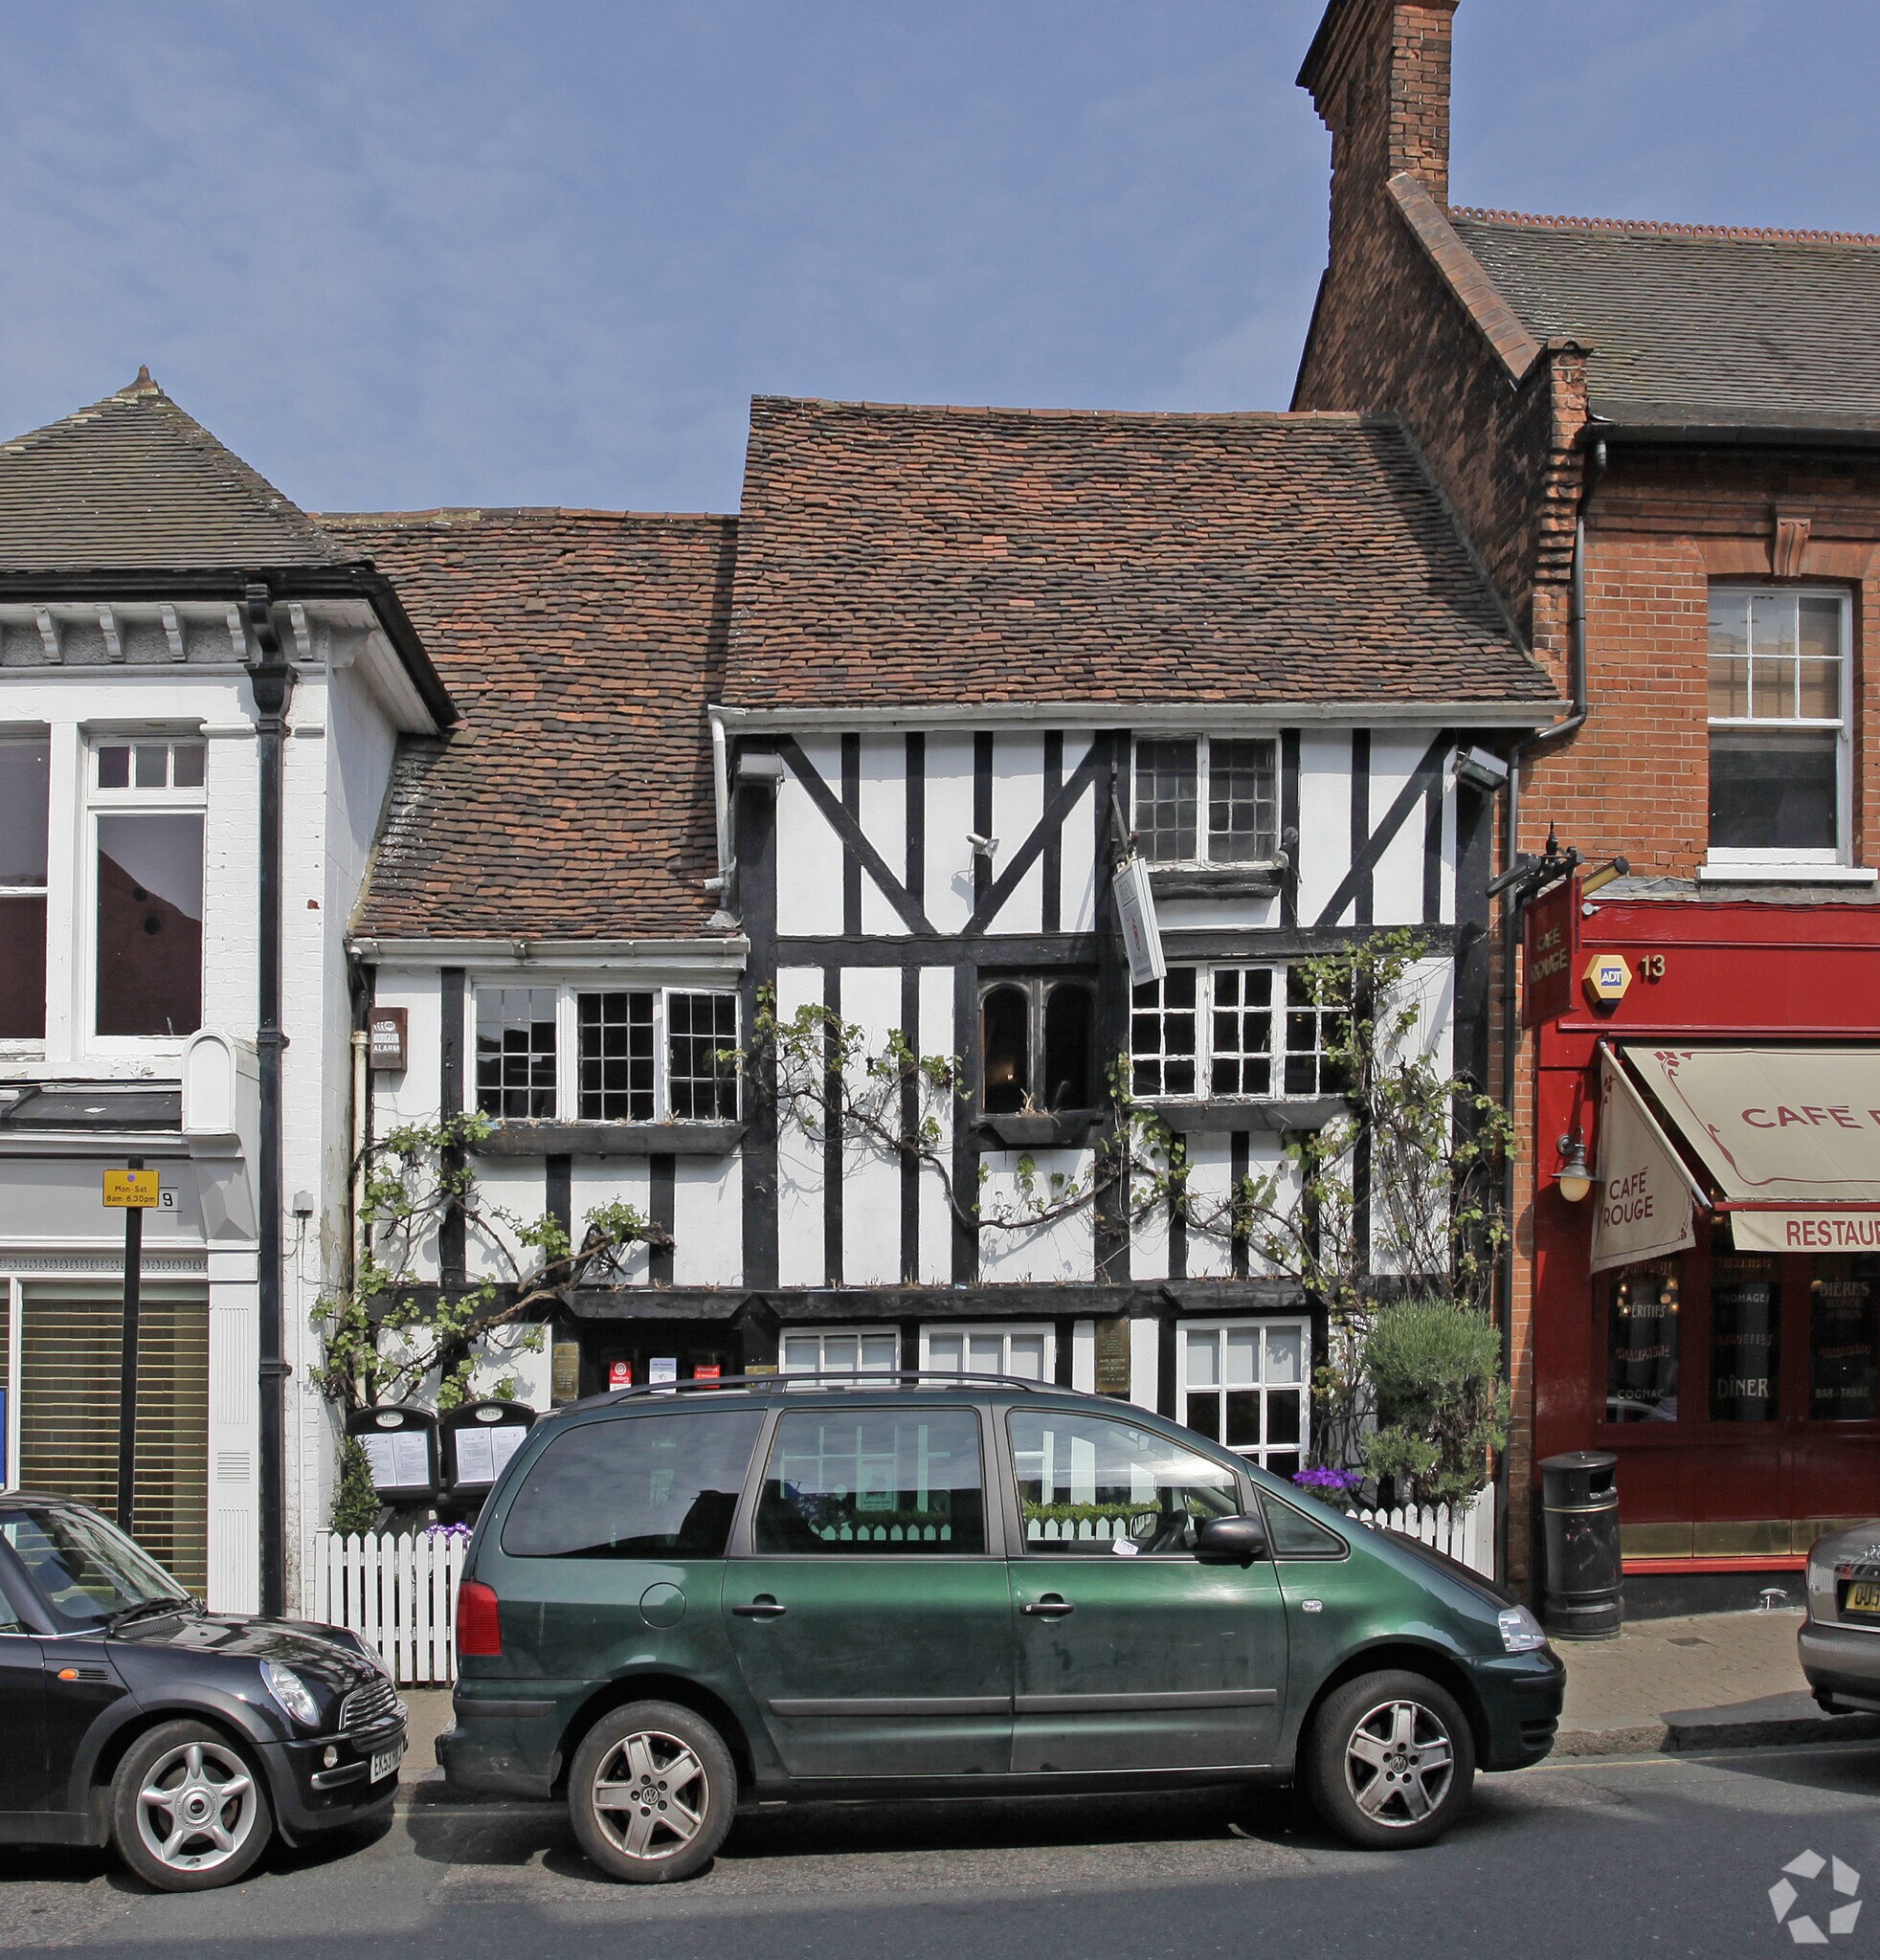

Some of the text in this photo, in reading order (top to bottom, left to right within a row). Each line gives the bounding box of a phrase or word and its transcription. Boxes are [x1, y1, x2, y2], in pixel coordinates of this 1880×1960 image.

[1530, 947, 1568, 985] ROUGE
[1642, 954, 1666, 976] 13
[1600, 971, 1622, 983] ADT
[1741, 1105, 1865, 1129] CAFÉ
[1609, 1166, 1648, 1200] CAFÉ
[162, 1192, 173, 1207] 9
[1603, 1195, 1654, 1228] ROUGE
[1820, 1278, 1869, 1298] BIÈRES
[1618, 1389, 1666, 1399] COGNAC
[1717, 1374, 1770, 1398] DÎNER
[1816, 1388, 1833, 1398] BAR
[1841, 1388, 1869, 1398] TABAC
